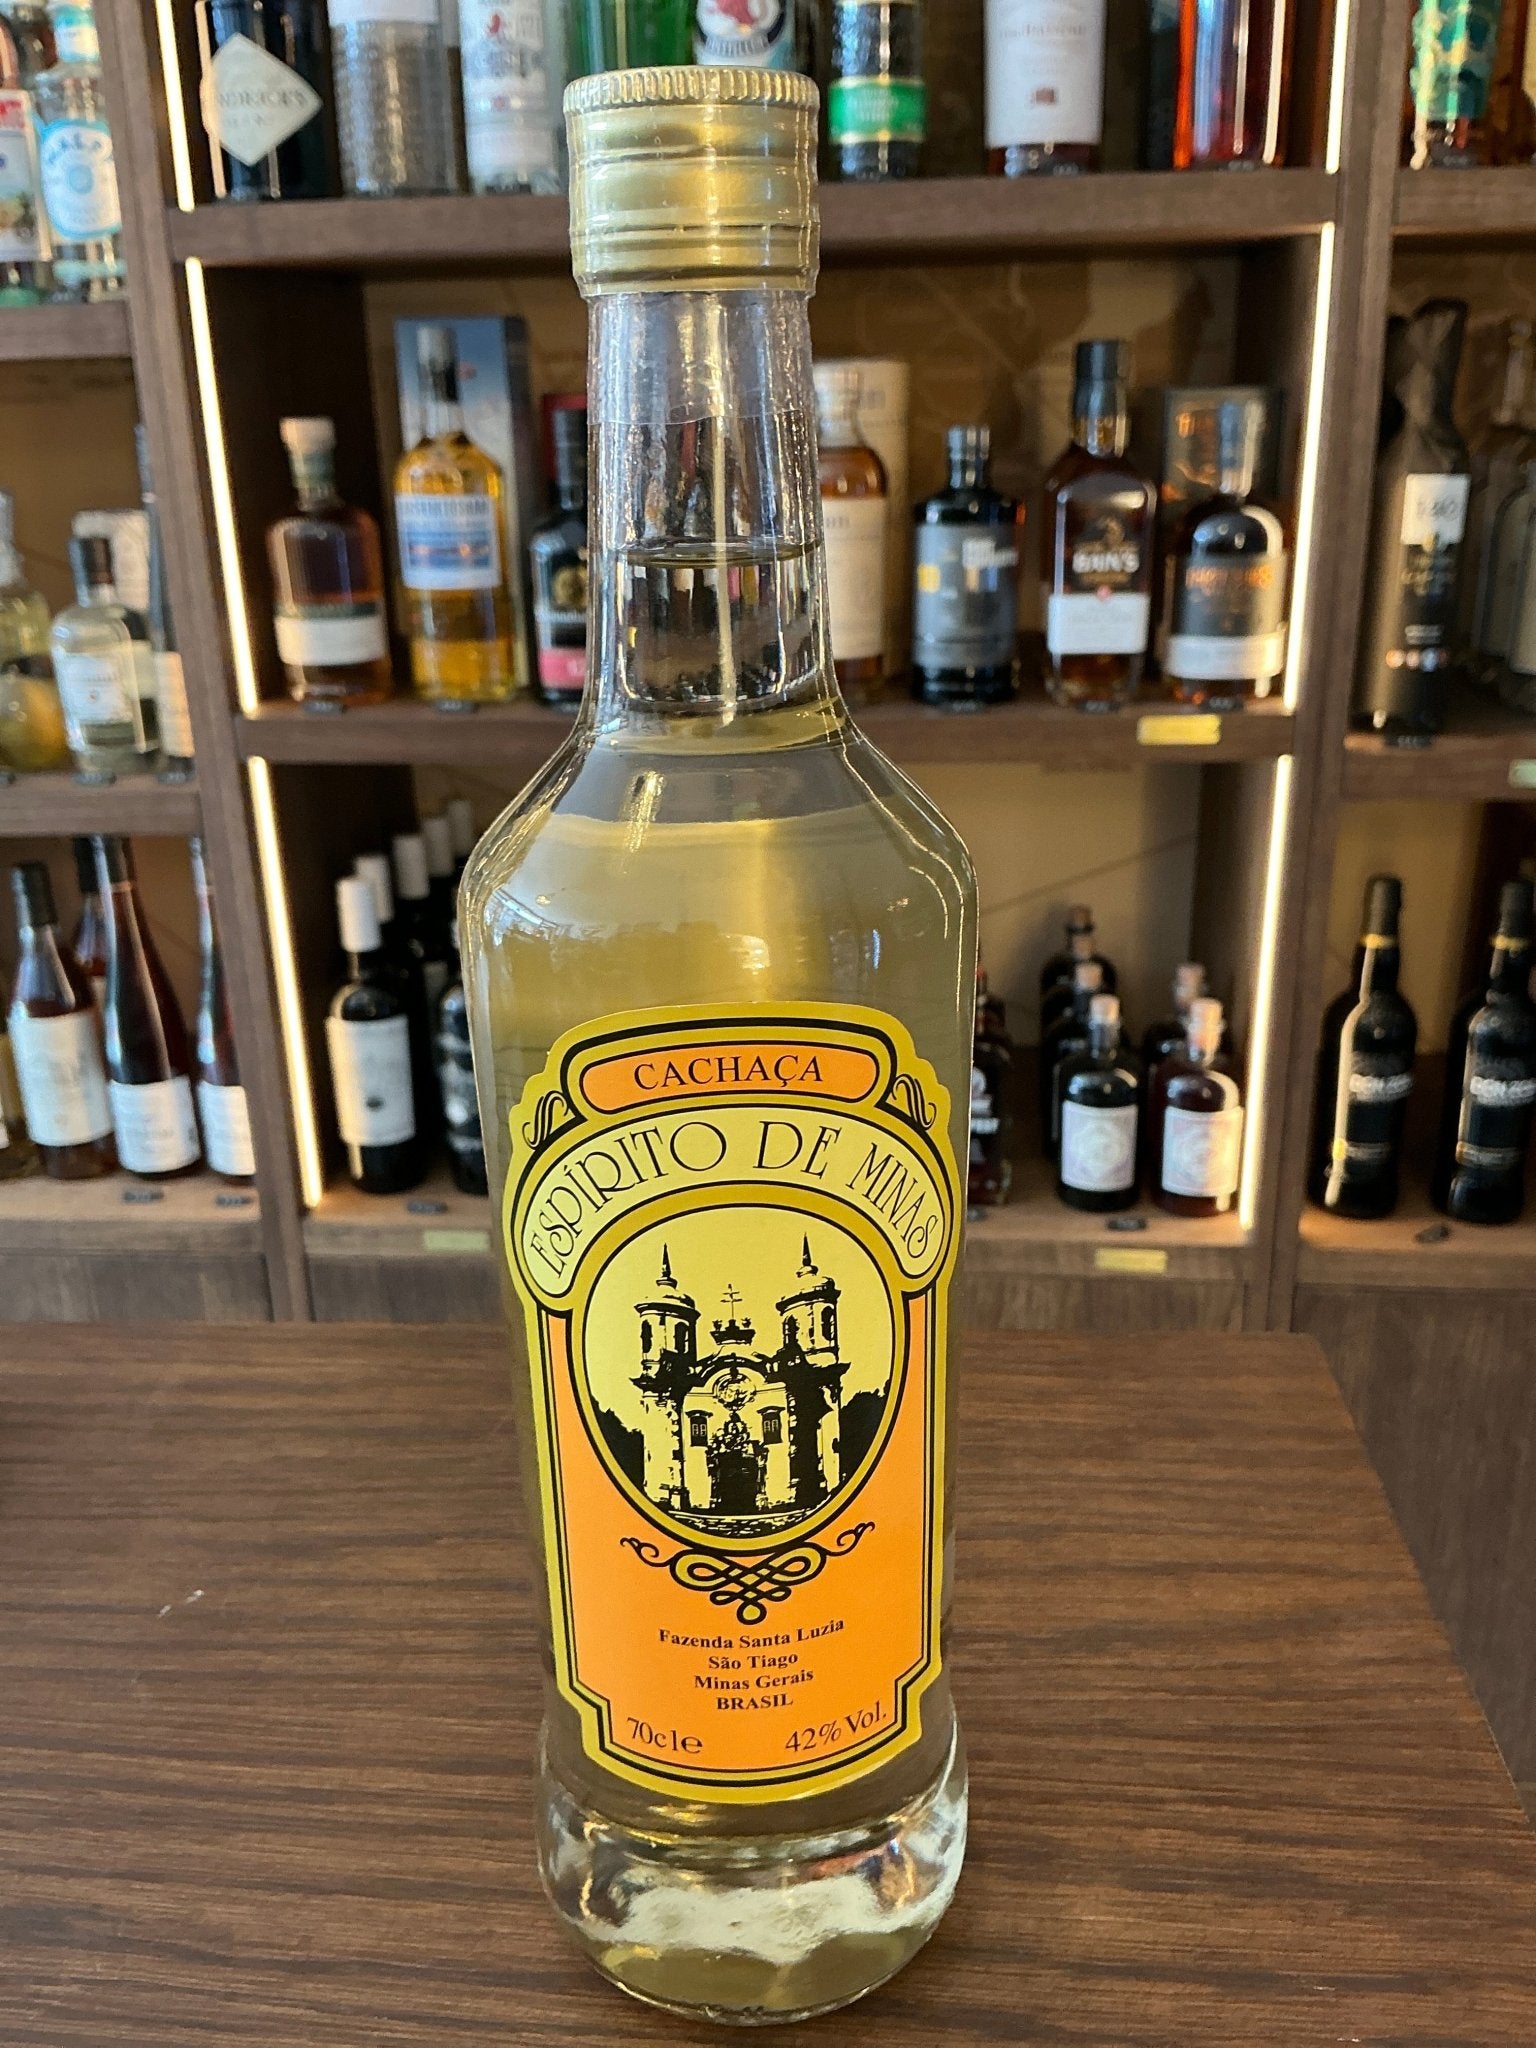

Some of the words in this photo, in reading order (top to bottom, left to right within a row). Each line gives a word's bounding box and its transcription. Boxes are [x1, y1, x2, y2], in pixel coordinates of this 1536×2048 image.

[633, 1054, 823, 1087] CACHAÇA
[531, 1121, 727, 1279] ESPÍRITO
[753, 1120, 842, 1179] DE
[845, 1142, 938, 1259] MINAS
[659, 1629, 733, 1648] Fazenda
[739, 1633, 791, 1649] Santa
[797, 1619, 845, 1642] Luzia
[708, 1655, 741, 1670] São
[746, 1653, 799, 1669] Tiago
[694, 1675, 750, 1690] Minas
[756, 1669, 814, 1689] Gerais
[716, 1693, 794, 1710] BRASIL
[785, 1713, 842, 1752] 42%
[846, 1700, 887, 1734] Vol.
